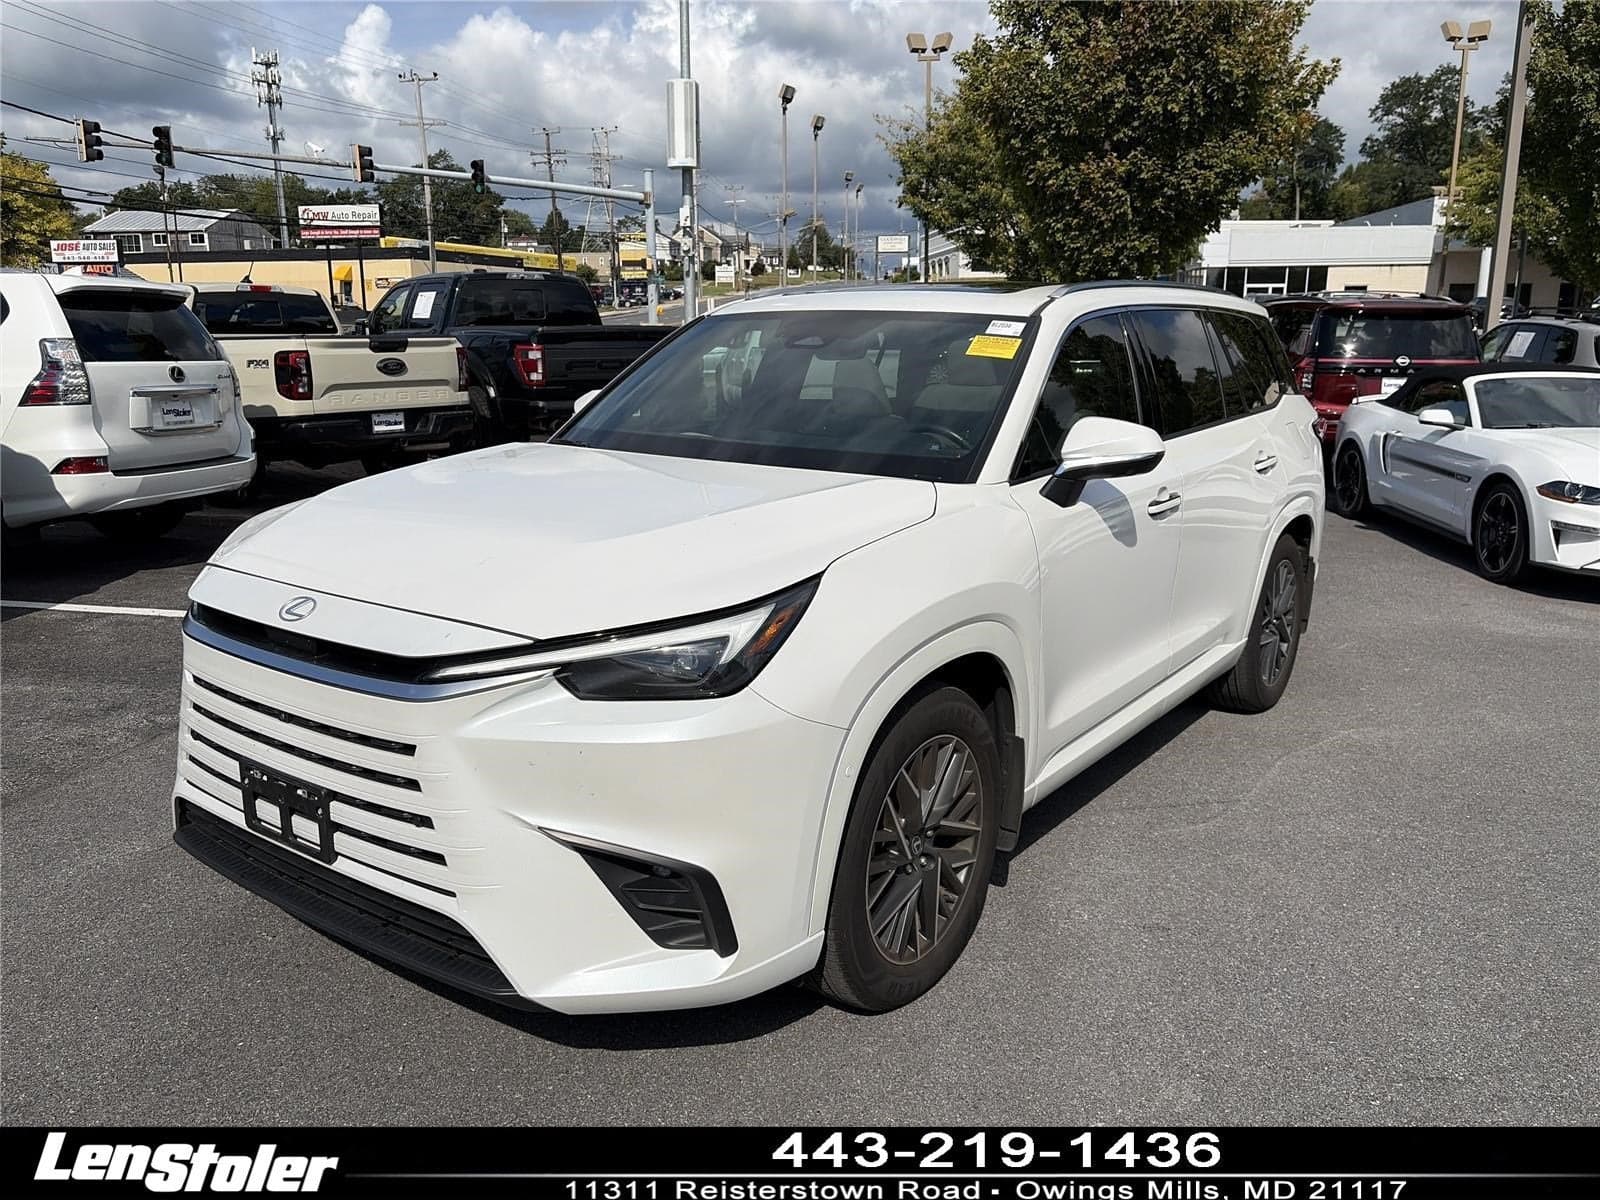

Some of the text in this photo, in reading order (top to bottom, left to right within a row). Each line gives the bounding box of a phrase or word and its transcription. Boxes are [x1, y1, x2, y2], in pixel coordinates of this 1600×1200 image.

[331, 211, 349, 219] Auto
[351, 211, 377, 221] Repair
[53, 241, 116, 252] JOSÉ AUTO SALES
[86, 264, 114, 272] AUTO
[246, 359, 270, 368] FX4
